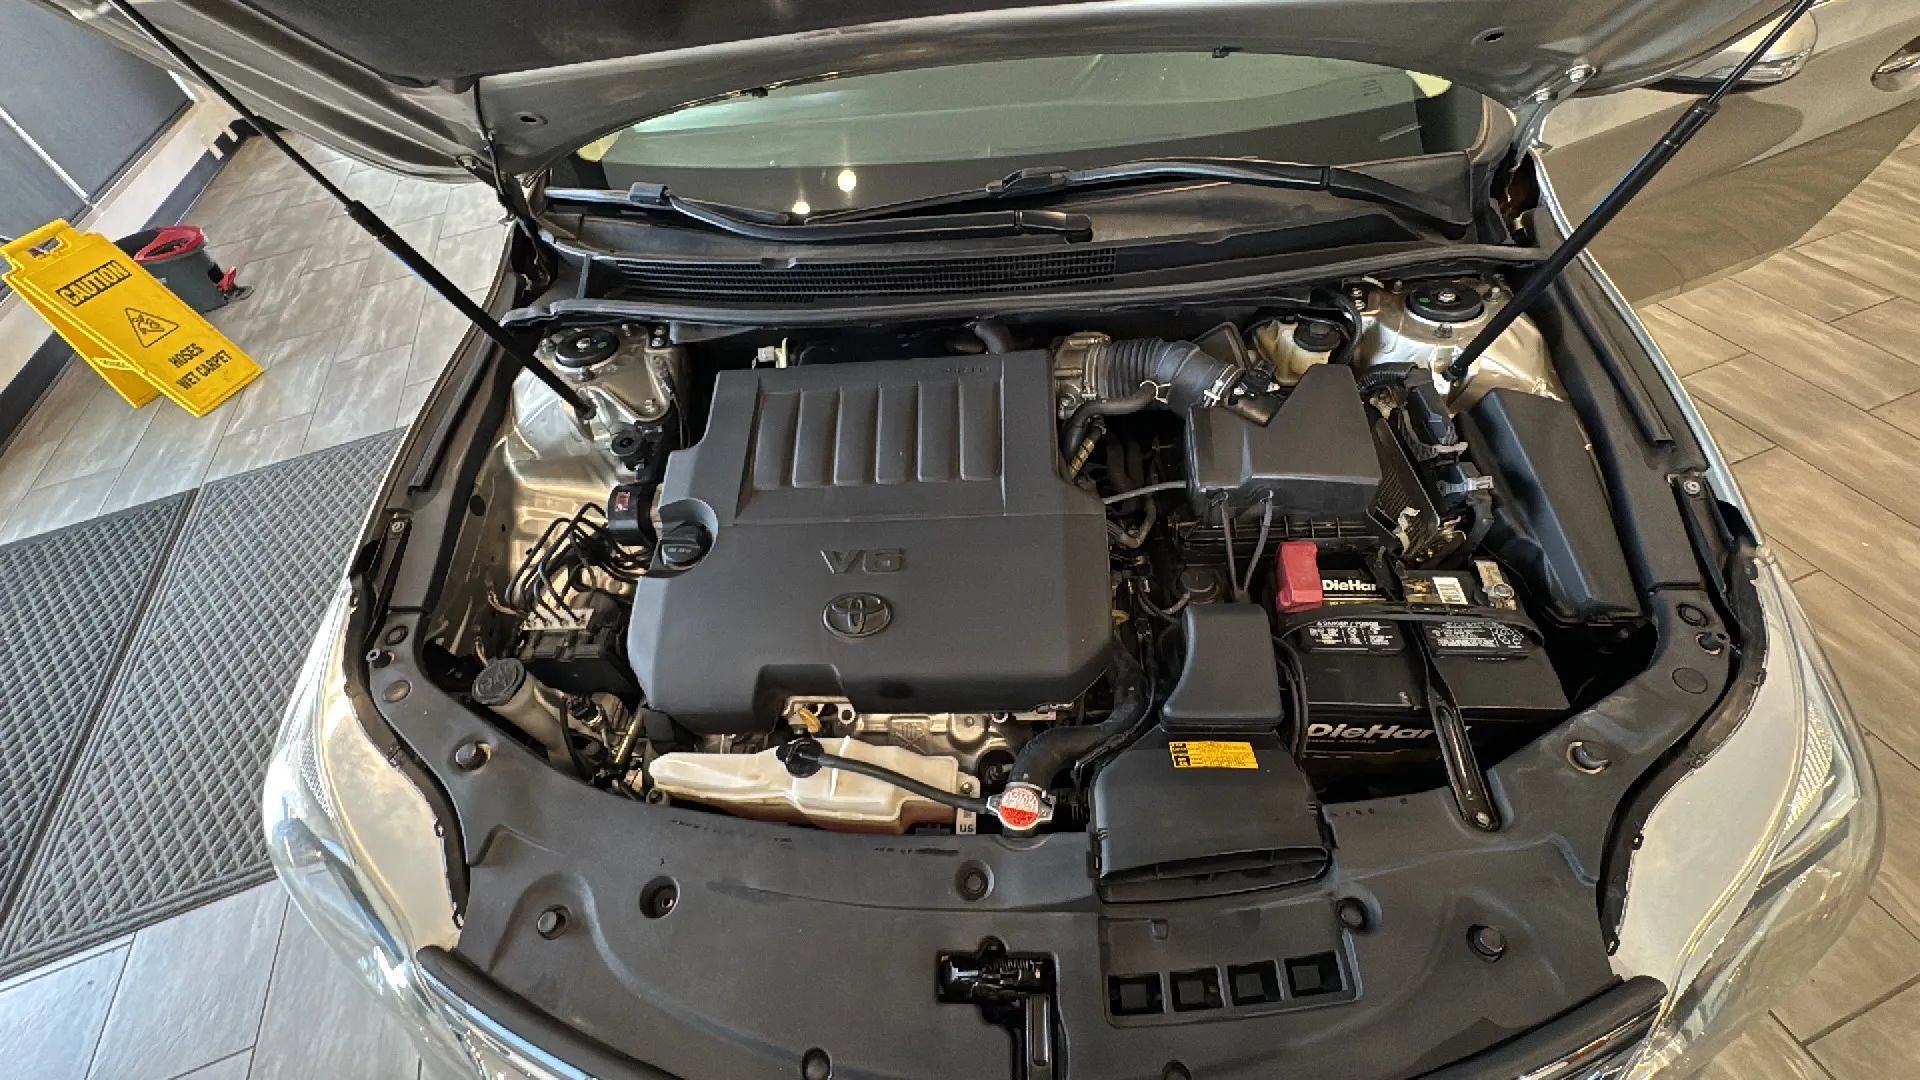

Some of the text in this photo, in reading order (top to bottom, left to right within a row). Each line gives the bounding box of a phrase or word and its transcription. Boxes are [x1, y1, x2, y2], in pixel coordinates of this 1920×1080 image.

[59, 261, 131, 305] CAUTION
[168, 342, 205, 368] HOSES
[176, 349, 233, 390] WET CARPET
[819, 548, 905, 575] V6
[1322, 579, 1376, 591] DieHar
[1308, 723, 1436, 739] DieHar
[959, 823, 975, 833] US
